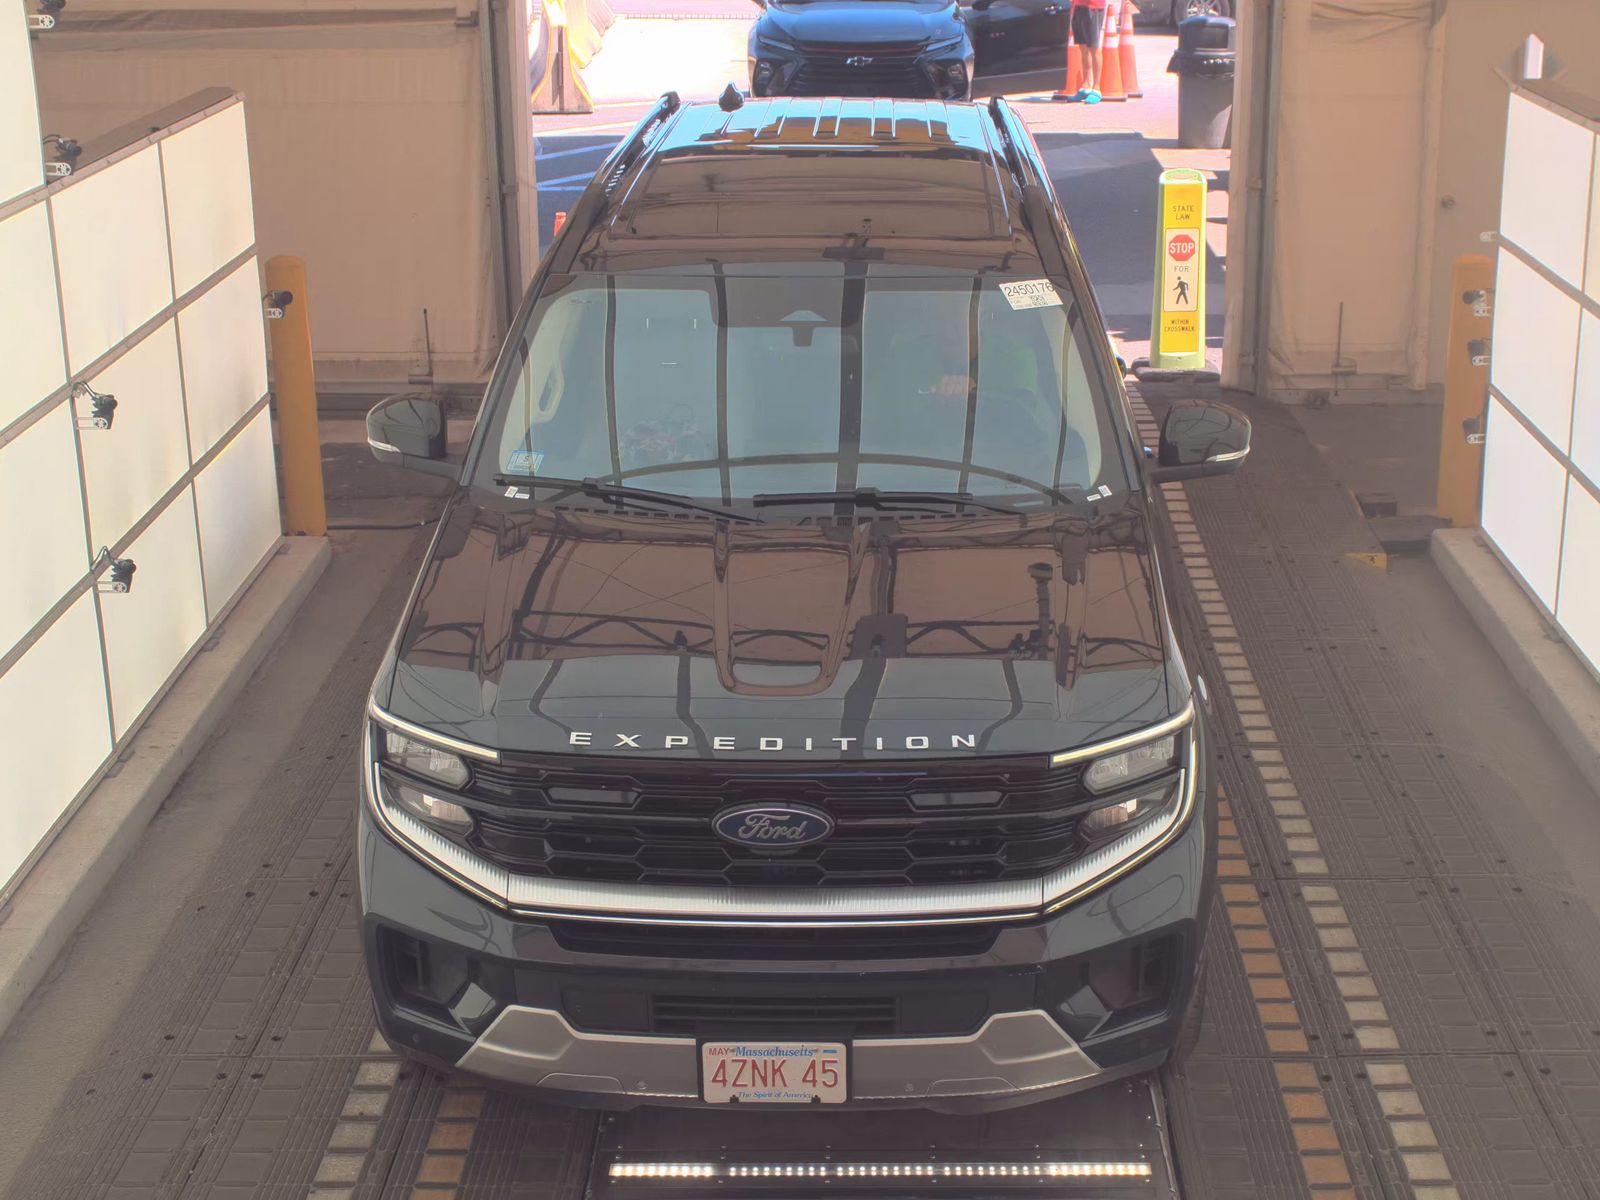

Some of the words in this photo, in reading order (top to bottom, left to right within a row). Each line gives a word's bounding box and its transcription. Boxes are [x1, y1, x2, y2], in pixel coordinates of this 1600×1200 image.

[1172, 205, 1195, 213] STATE
[1169, 242, 1194, 254] STOP
[1174, 265, 1189, 273] FOR
[1004, 281, 1055, 297] 2450176
[569, 731, 976, 752] EXPEDITION
[737, 814, 806, 840] Ford
[708, 1047, 730, 1056] MAY
[735, 1046, 814, 1057] Massachusetts
[711, 1059, 788, 1088] 4ZNK
[801, 1059, 839, 1088] 45
